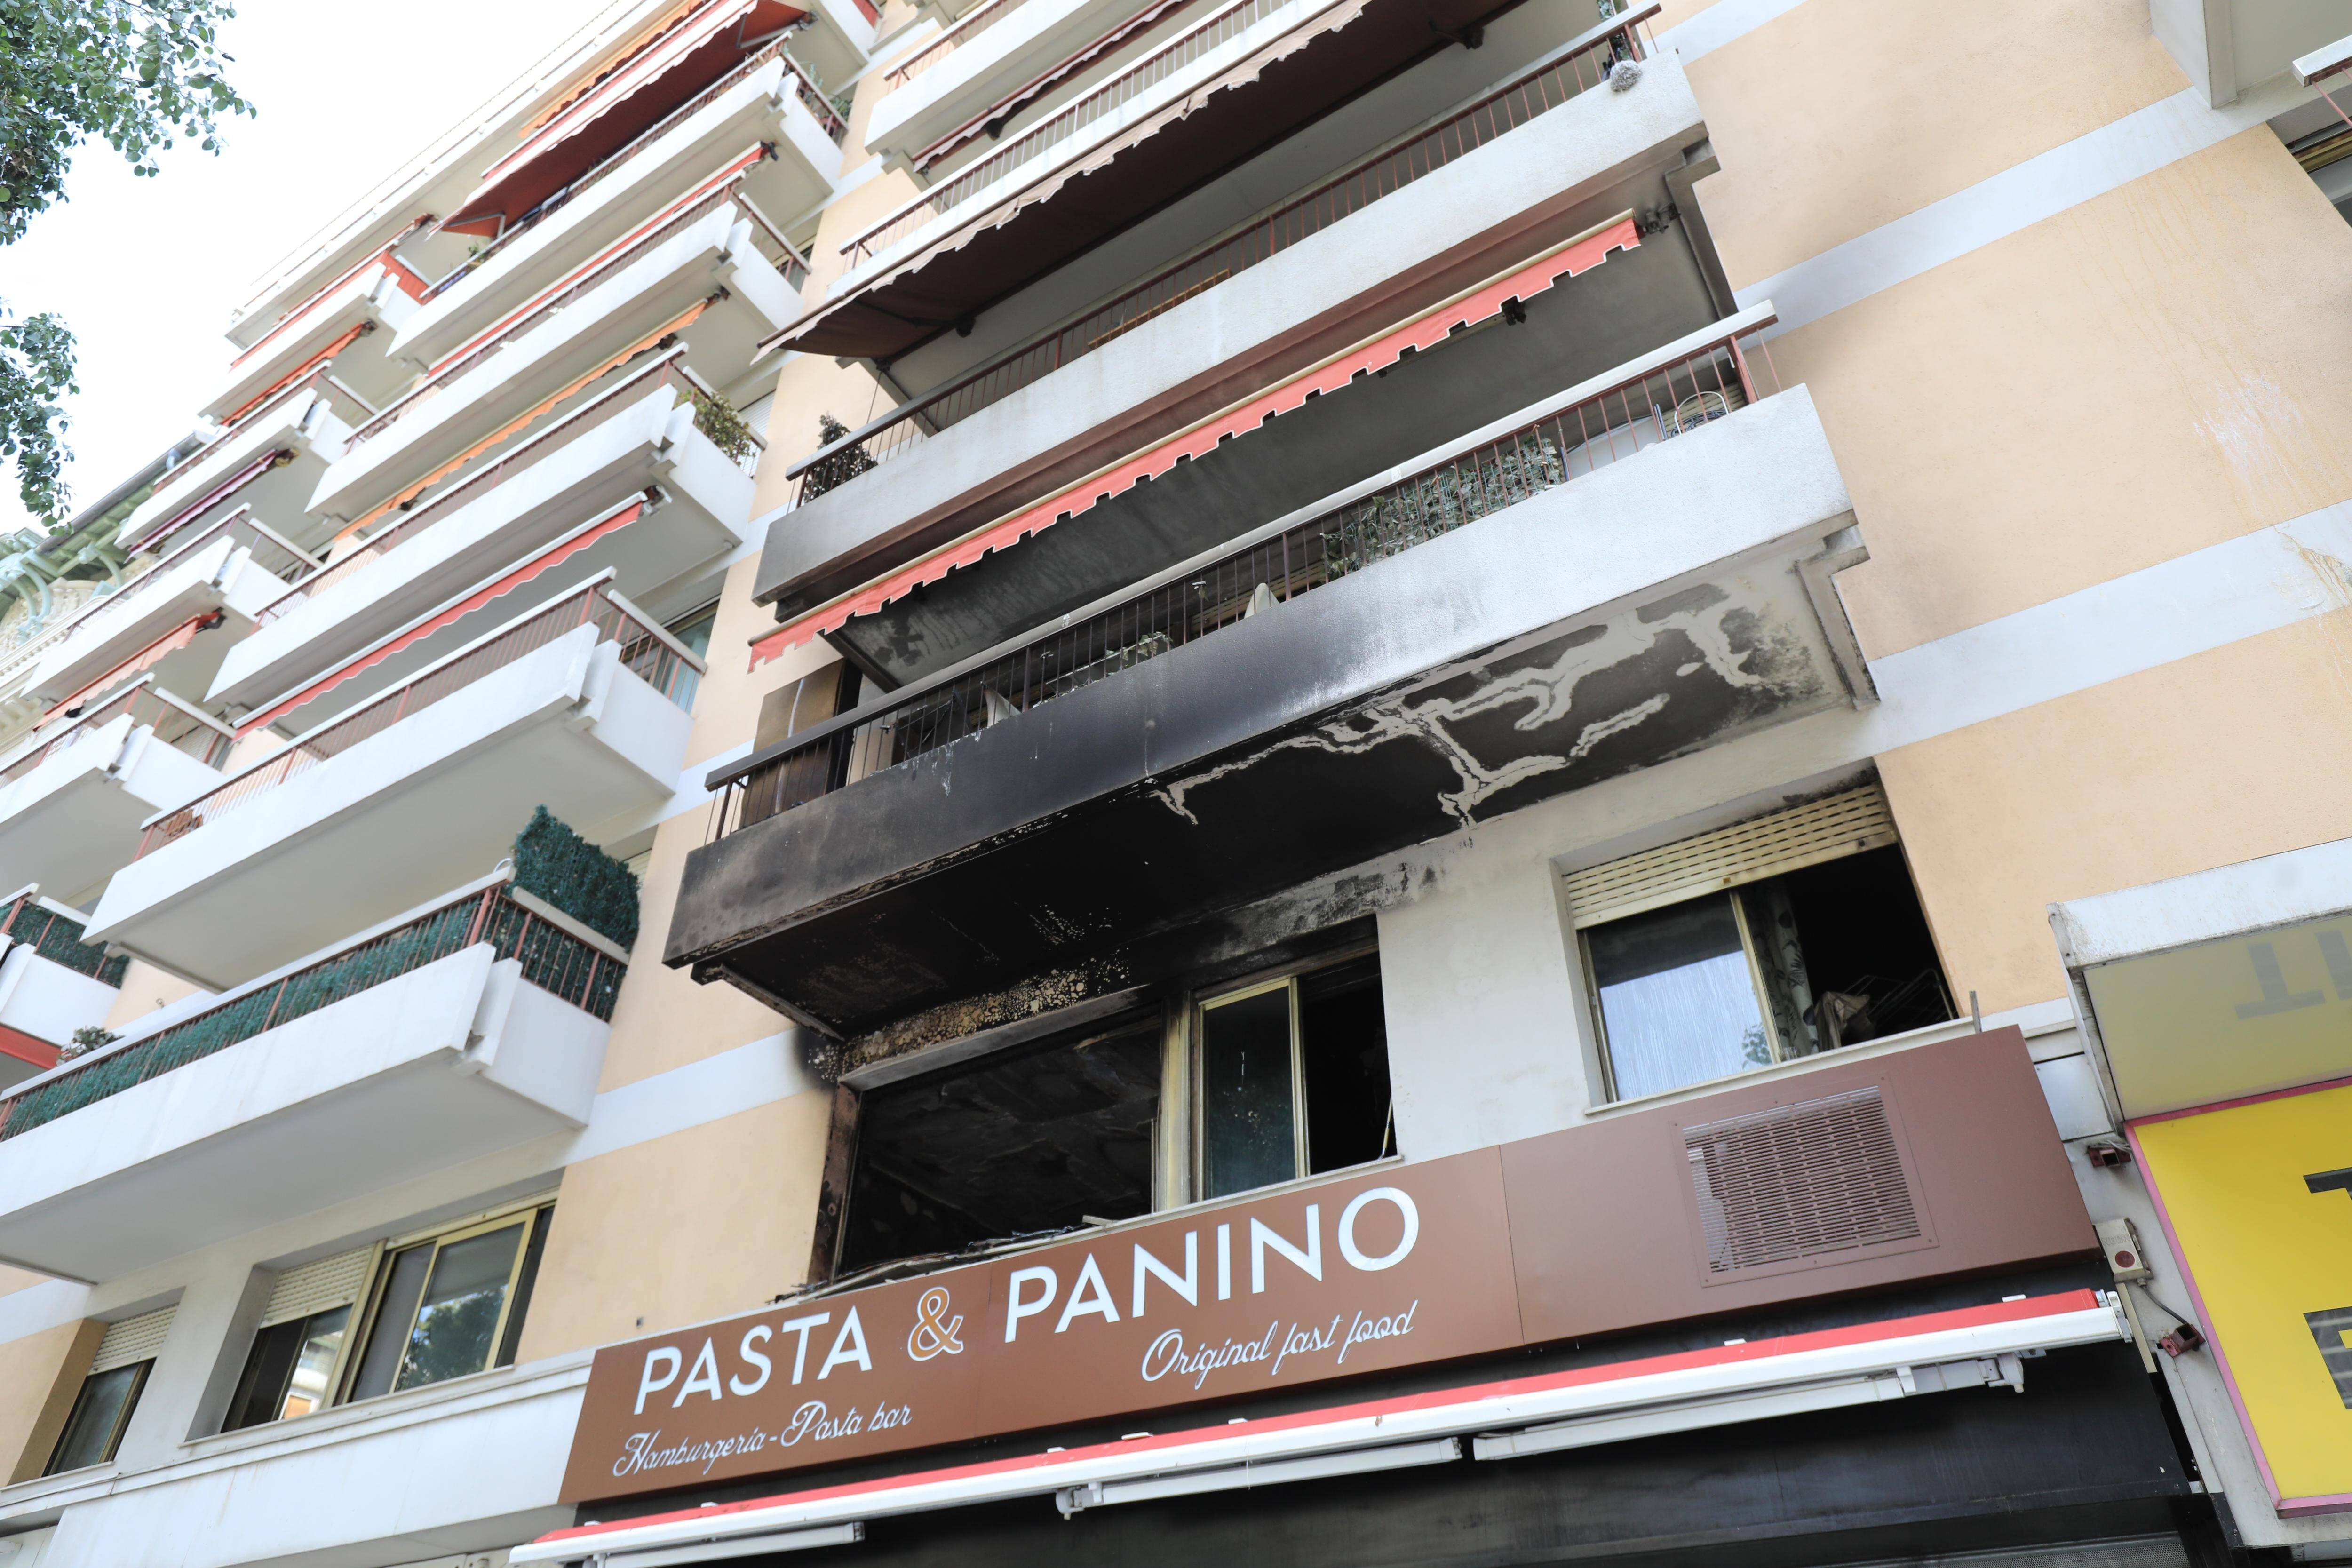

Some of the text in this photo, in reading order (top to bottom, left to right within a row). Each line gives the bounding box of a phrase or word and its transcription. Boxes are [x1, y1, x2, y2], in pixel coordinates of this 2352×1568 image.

[633, 1185, 1420, 1416] PASTA & PANINO
[1141, 1299, 1419, 1390] Original fast food
[867, 1401, 913, 1432] bar
